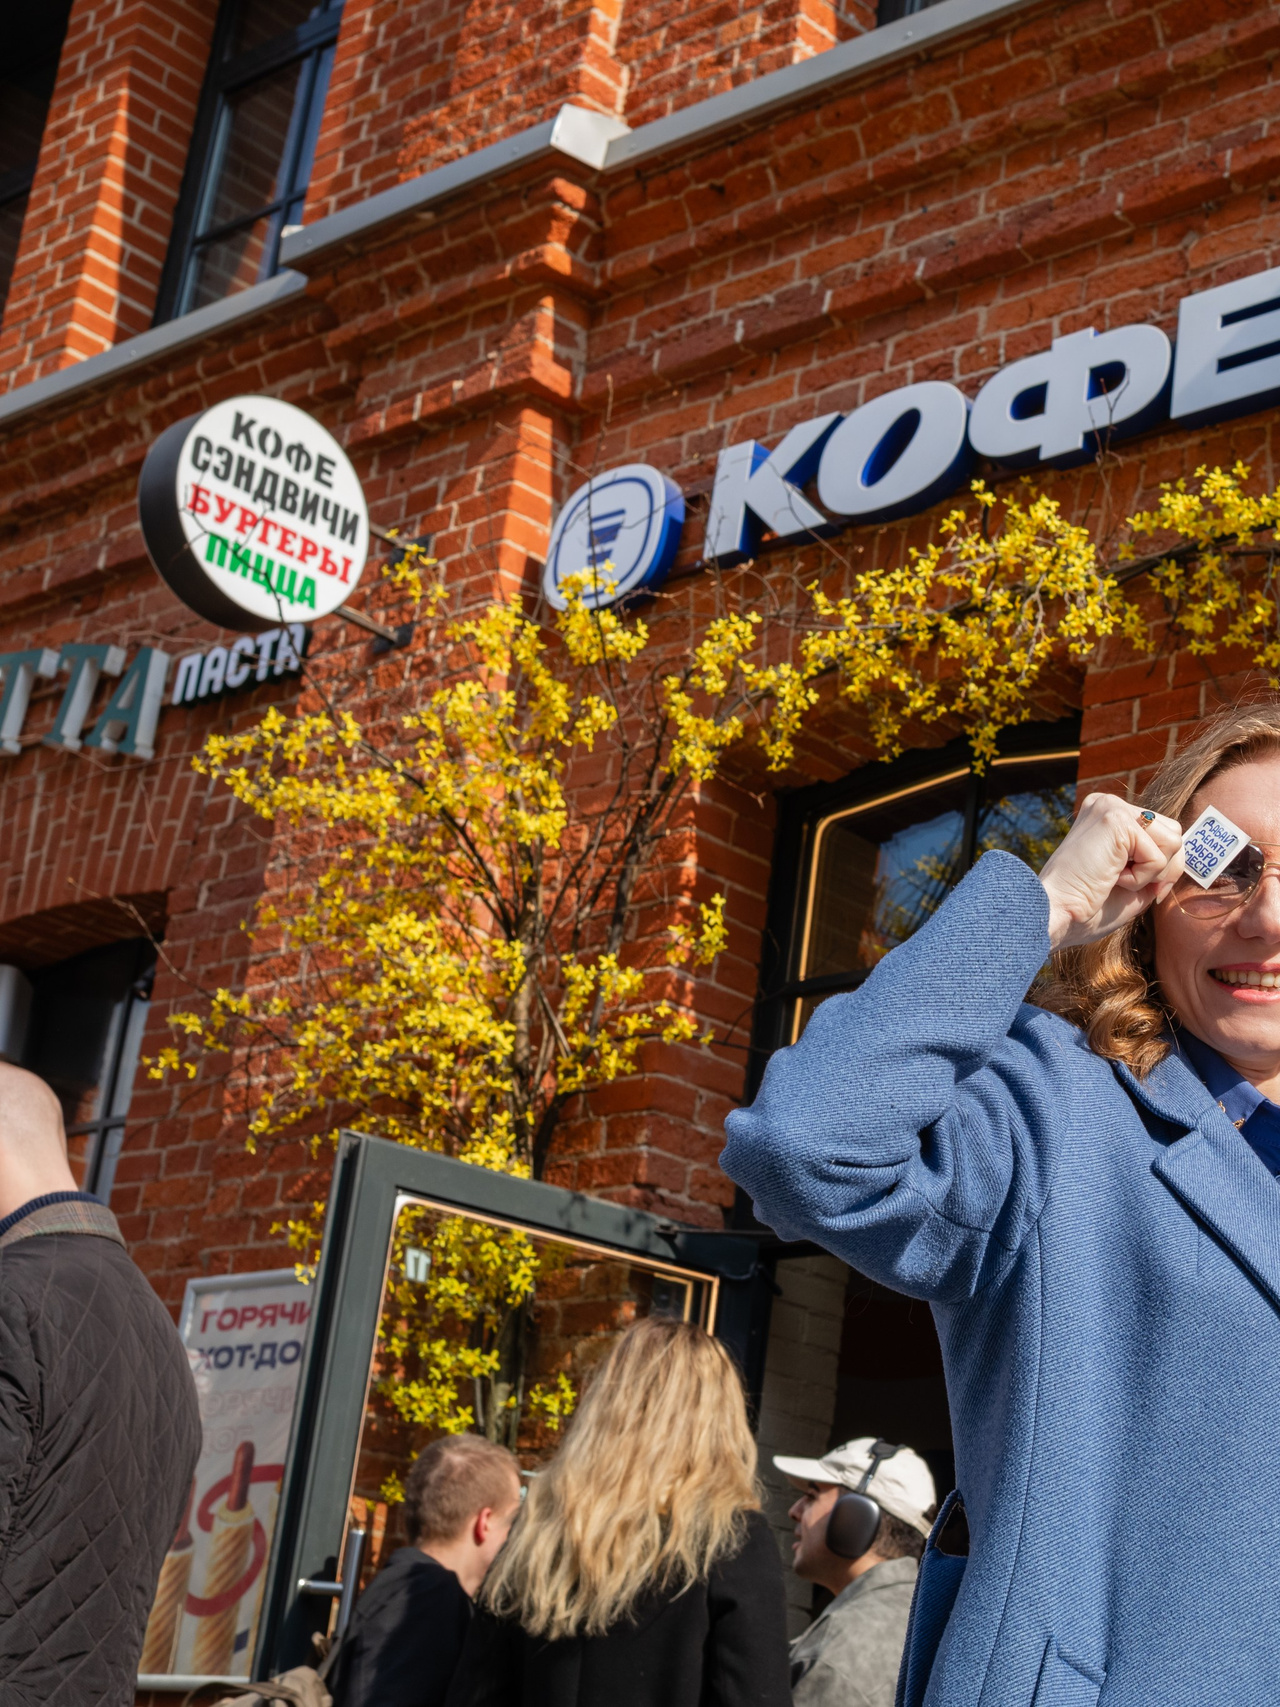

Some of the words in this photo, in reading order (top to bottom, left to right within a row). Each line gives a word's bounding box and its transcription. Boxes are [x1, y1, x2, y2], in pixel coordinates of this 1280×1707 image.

[230, 410, 338, 490] КОФЕ
[190, 436, 360, 546] СЭНДВИЧИ
[187, 483, 353, 584] БУРГЕРЫ
[204, 531, 317, 610] ПИЦЦА
[172, 623, 307, 705] ПАСТА
[1185, 838, 1219, 867] ДОБРО
[1185, 848, 1211, 878] МЕСТЕ
[1195, 829, 1227, 858] ДЕЛАТЬ
[1203, 819, 1238, 848] ДАВАЙ
